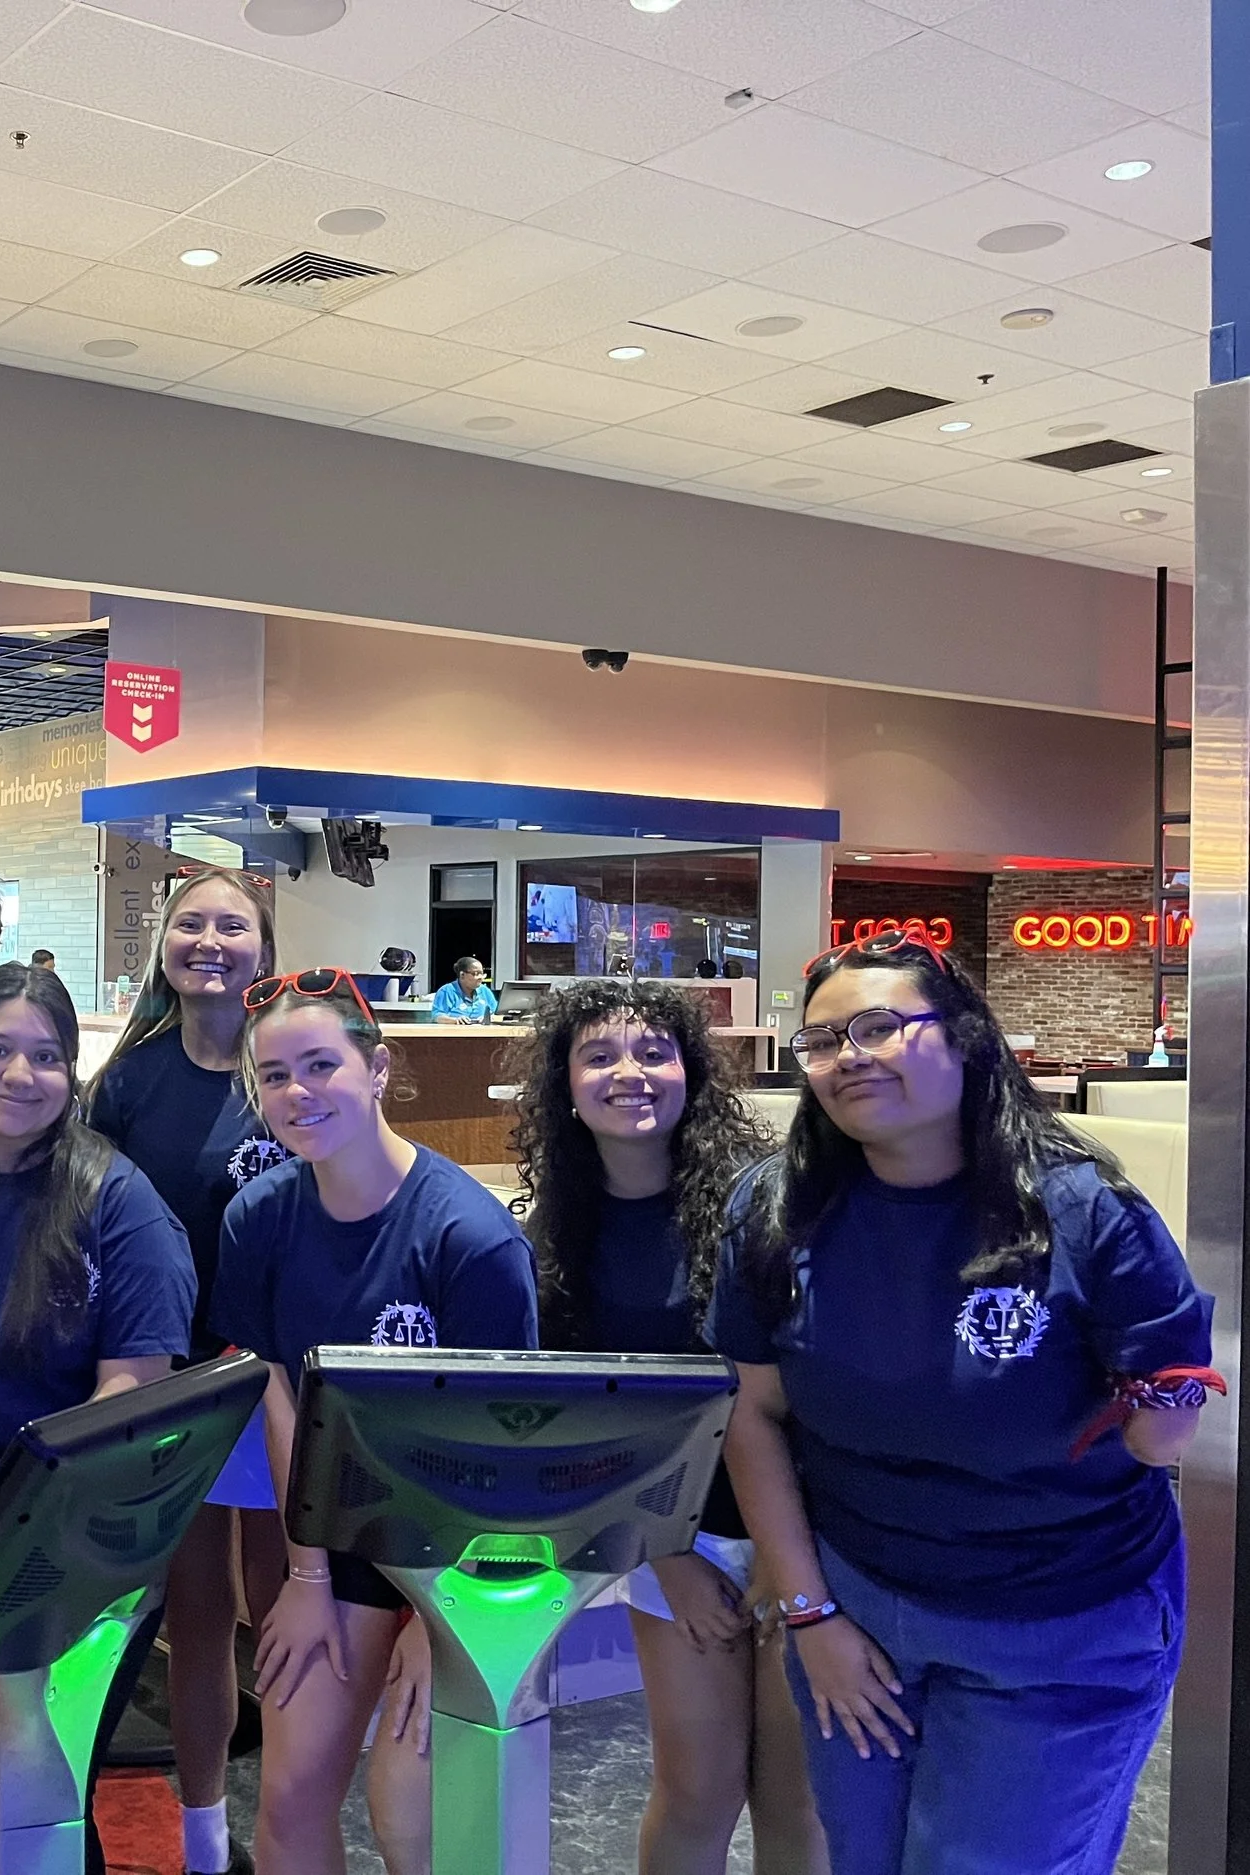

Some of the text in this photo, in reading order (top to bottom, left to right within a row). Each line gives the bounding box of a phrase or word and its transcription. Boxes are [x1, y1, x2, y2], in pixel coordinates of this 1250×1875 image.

[111, 679, 175, 693] RESERVATION
[126, 672, 161, 682] ONLINE
[121, 689, 165, 700] CHECK-IN
[42, 716, 104, 742] memories
[51, 738, 107, 775] unique
[65, 776, 86, 794] skee
[89, 773, 105, 789] ba
[114, 889, 140, 983] xcellent
[1013, 915, 1131, 947] GOOD
